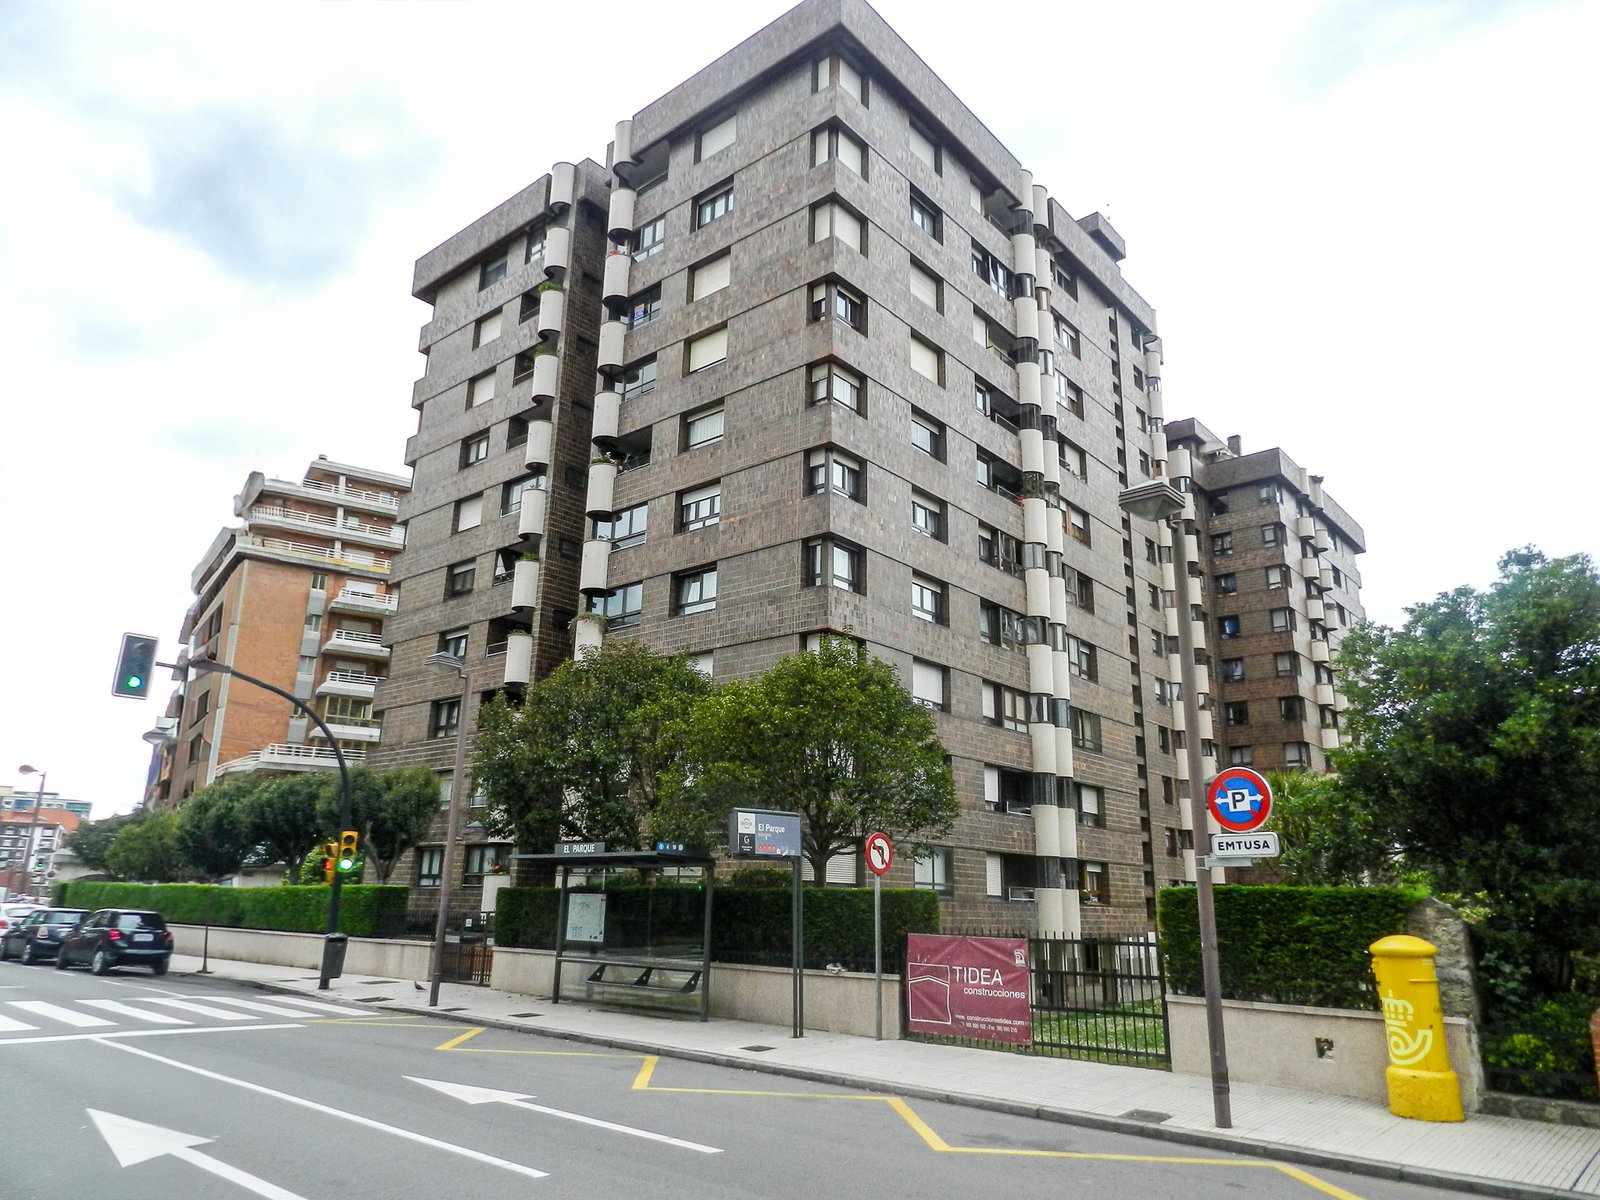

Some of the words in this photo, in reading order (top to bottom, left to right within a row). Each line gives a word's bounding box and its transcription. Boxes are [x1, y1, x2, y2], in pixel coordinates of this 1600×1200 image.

[1231, 791, 1246, 809] P
[758, 823, 765, 832] El
[765, 823, 786, 834] Parque
[563, 844, 570, 853] EL
[572, 843, 595, 853] PARQUE
[1217, 840, 1270, 851] EMTUSA
[952, 966, 1004, 986] TIDEA
[963, 987, 1026, 999] construcciones
